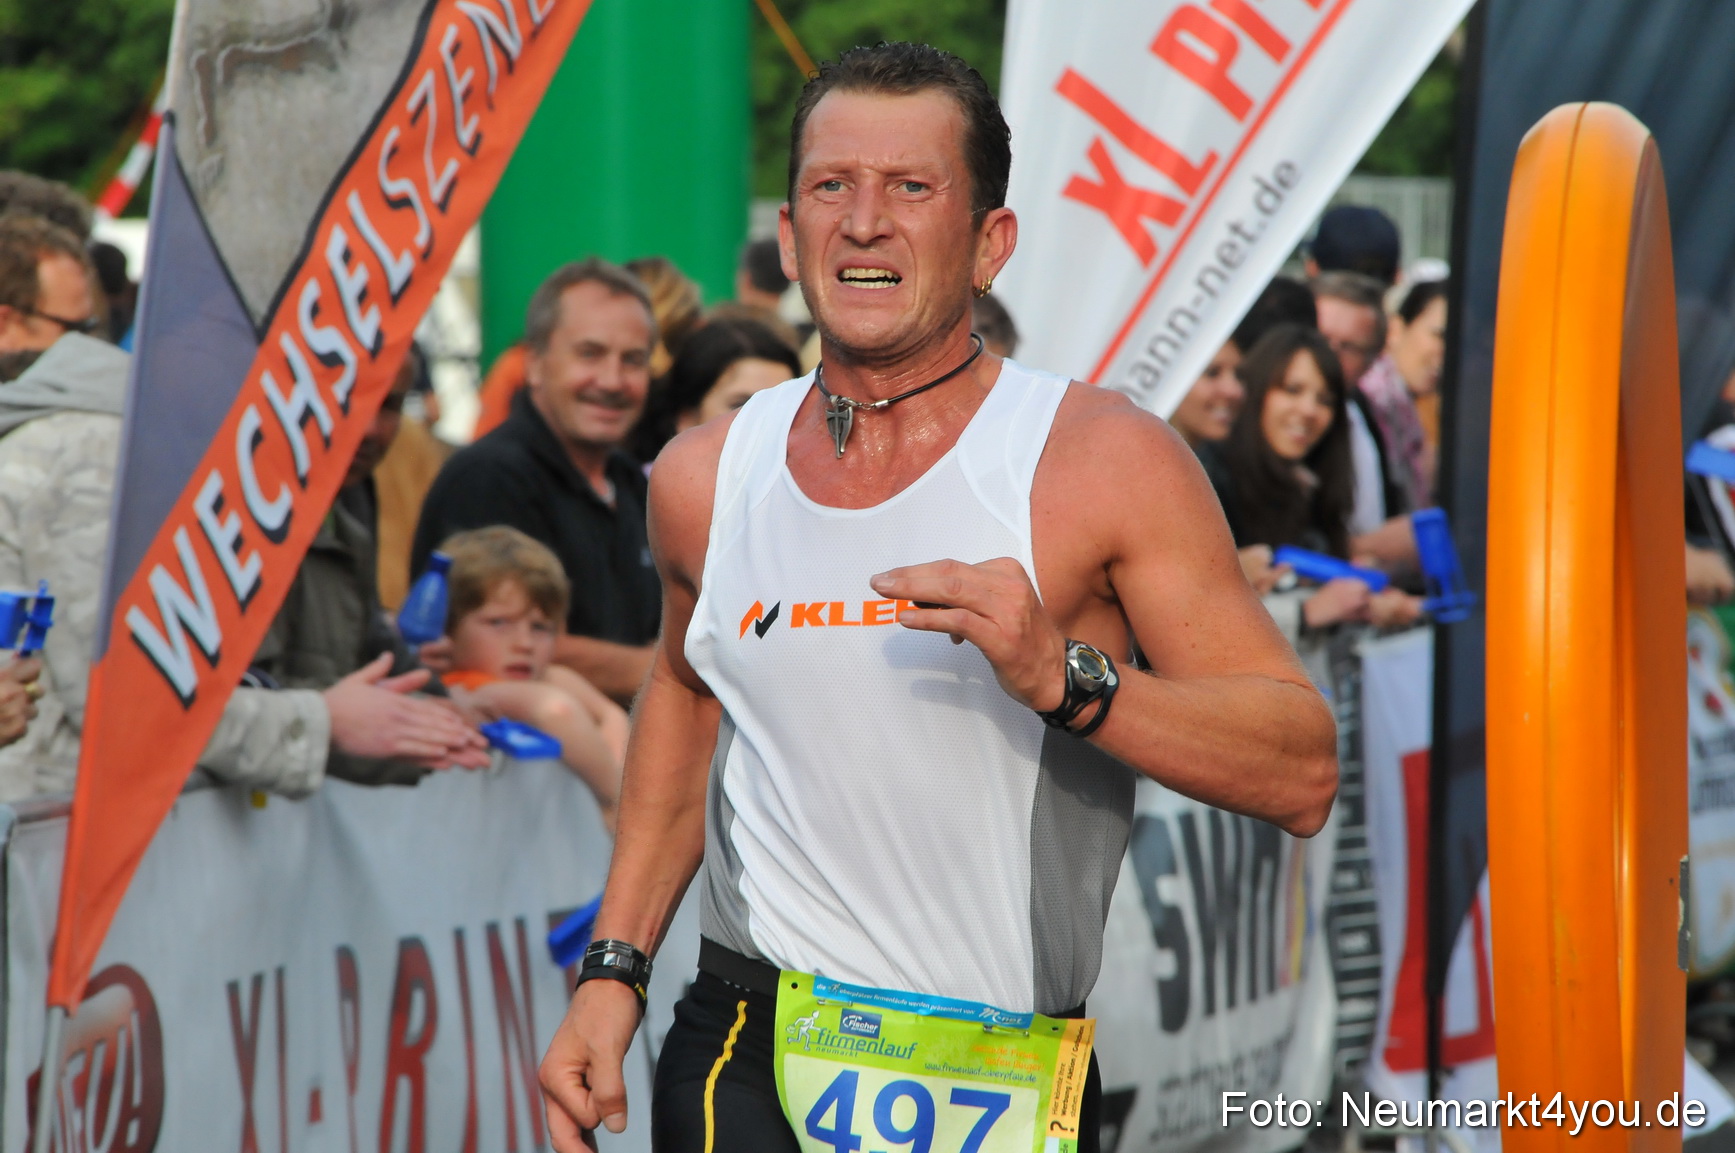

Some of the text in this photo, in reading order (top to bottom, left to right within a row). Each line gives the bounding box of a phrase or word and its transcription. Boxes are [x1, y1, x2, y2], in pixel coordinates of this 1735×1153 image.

[1053, 66, 1220, 269] XL
[848, 1018, 878, 1031] Fischer
[908, 1000, 930, 1009] werden
[930, 1004, 962, 1014] präsentiert
[226, 908, 580, 1153] XL-PRIN
[816, 1046, 858, 1057] neumarkt
[817, 1027, 918, 1059] firmenlauf
[1061, 1085, 1072, 1116] Werbung
[1067, 1057, 1076, 1080] Aktion
[805, 1069, 1011, 1153] 497
